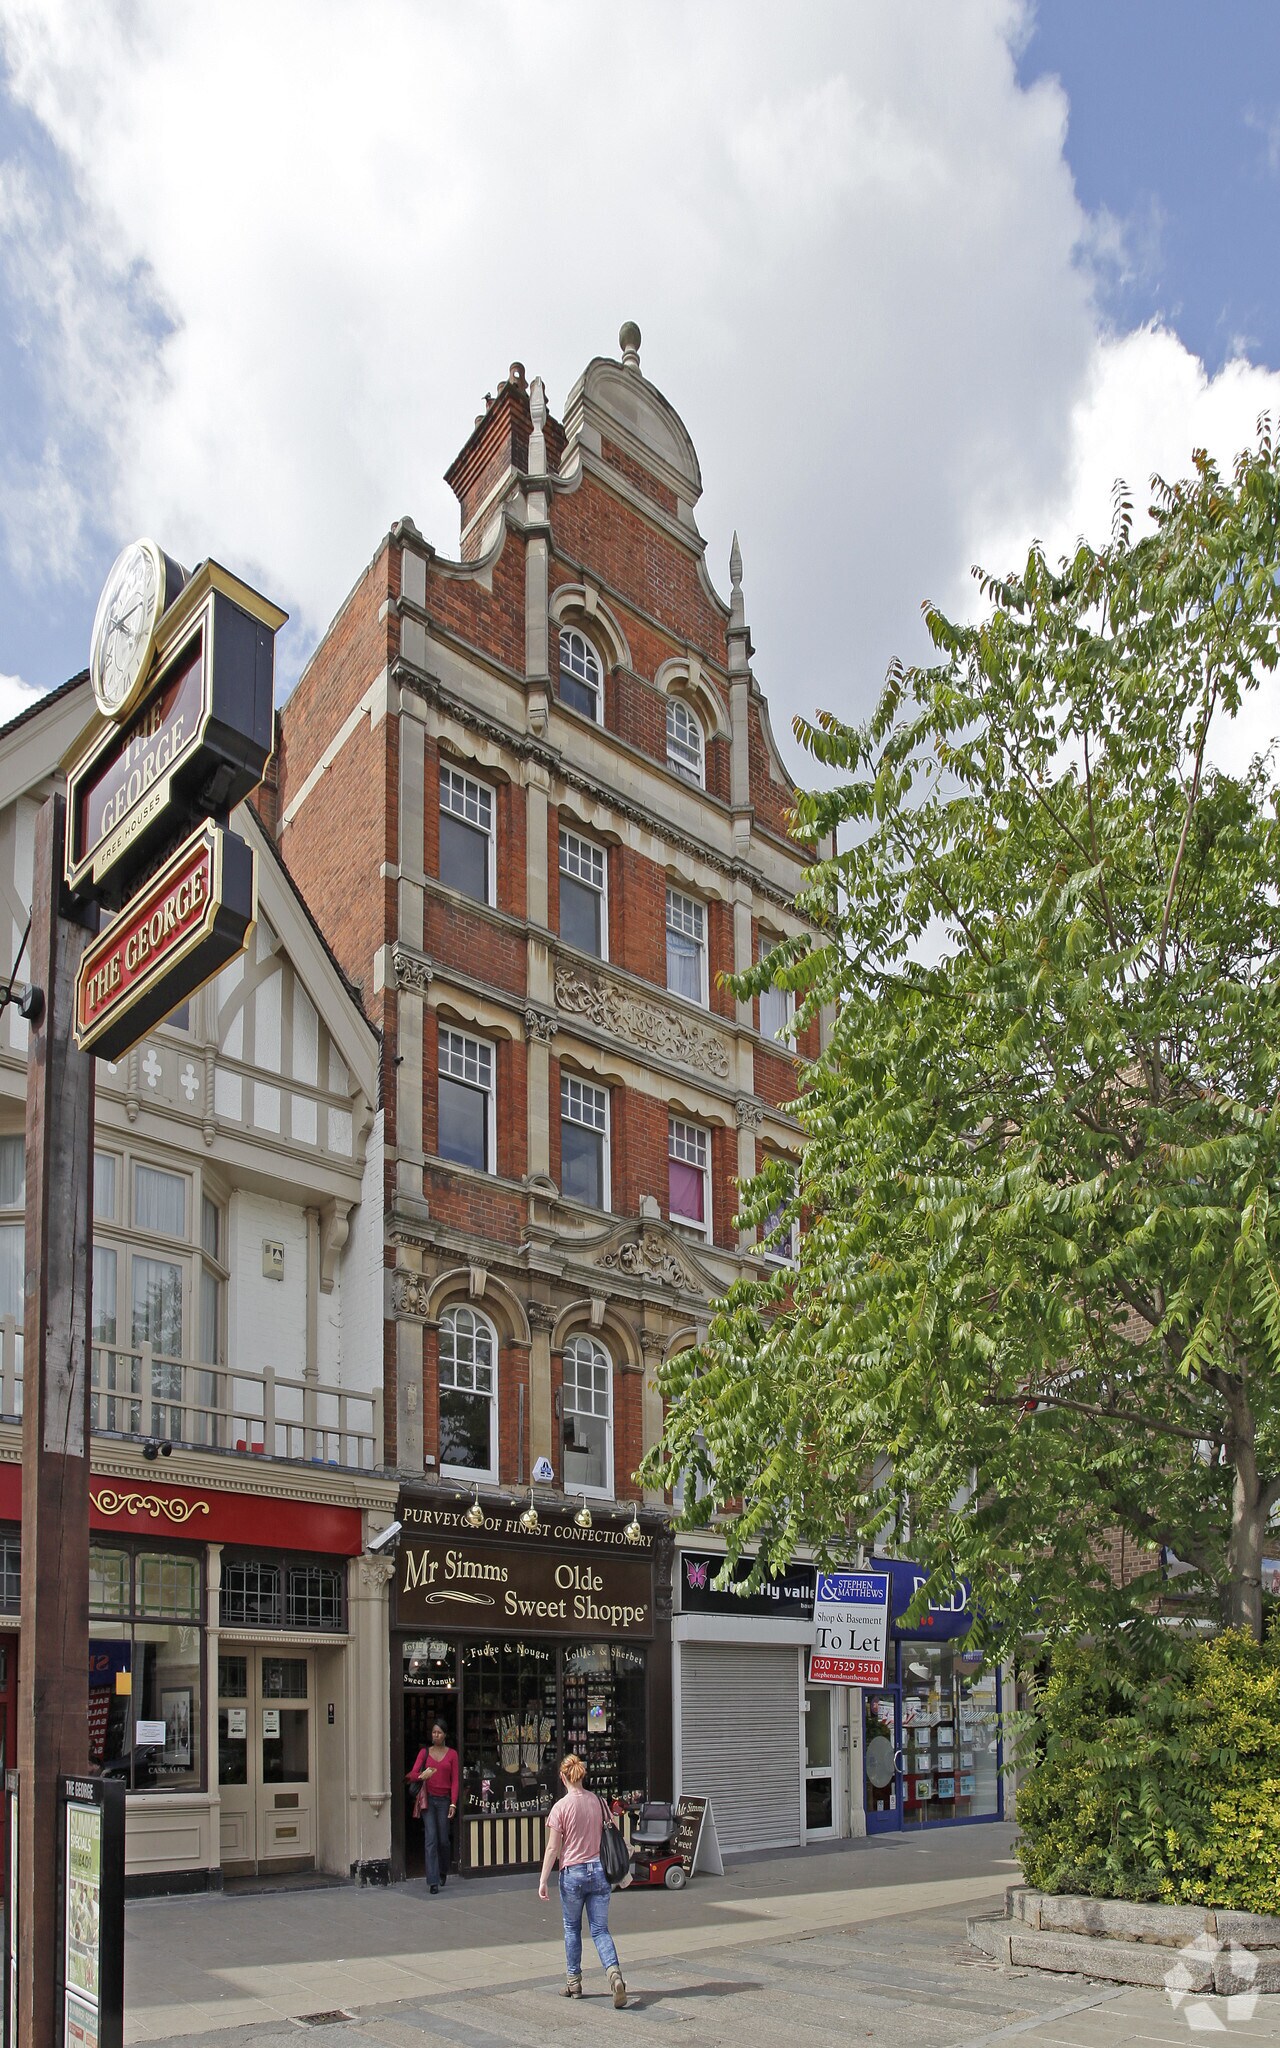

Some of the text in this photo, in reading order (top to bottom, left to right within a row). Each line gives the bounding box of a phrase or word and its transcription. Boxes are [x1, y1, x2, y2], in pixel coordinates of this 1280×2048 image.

[121, 700, 163, 773] THE
[100, 715, 185, 837] GEORGE
[101, 793, 161, 867] FREE HOUSES
[86, 868, 205, 1011] THE GEORGE
[403, 1508, 479, 1528] PURVEYO
[484, 1517, 502, 1531] OF
[403, 1550, 508, 1593] Mr Simms
[554, 1564, 603, 1591] Olde
[821, 1578, 884, 1600] & MATTHEWS
[838, 1580, 873, 1589] STEPHEN
[504, 1590, 567, 1616] Sweet
[817, 1611, 881, 1625] Shop & Basement
[816, 1627, 880, 1652] To Let
[470, 1643, 550, 1661] Fudge & Nougat
[610, 1647, 642, 1665] Sherbet
[814, 1659, 880, 1674] 020 7529 5510
[403, 1674, 455, 1686] Sweet Peanuts
[169, 1766, 186, 1774] ALES
[66, 1780, 93, 1799] THE GEORGE
[469, 1793, 554, 1811] Finest Liquorices
